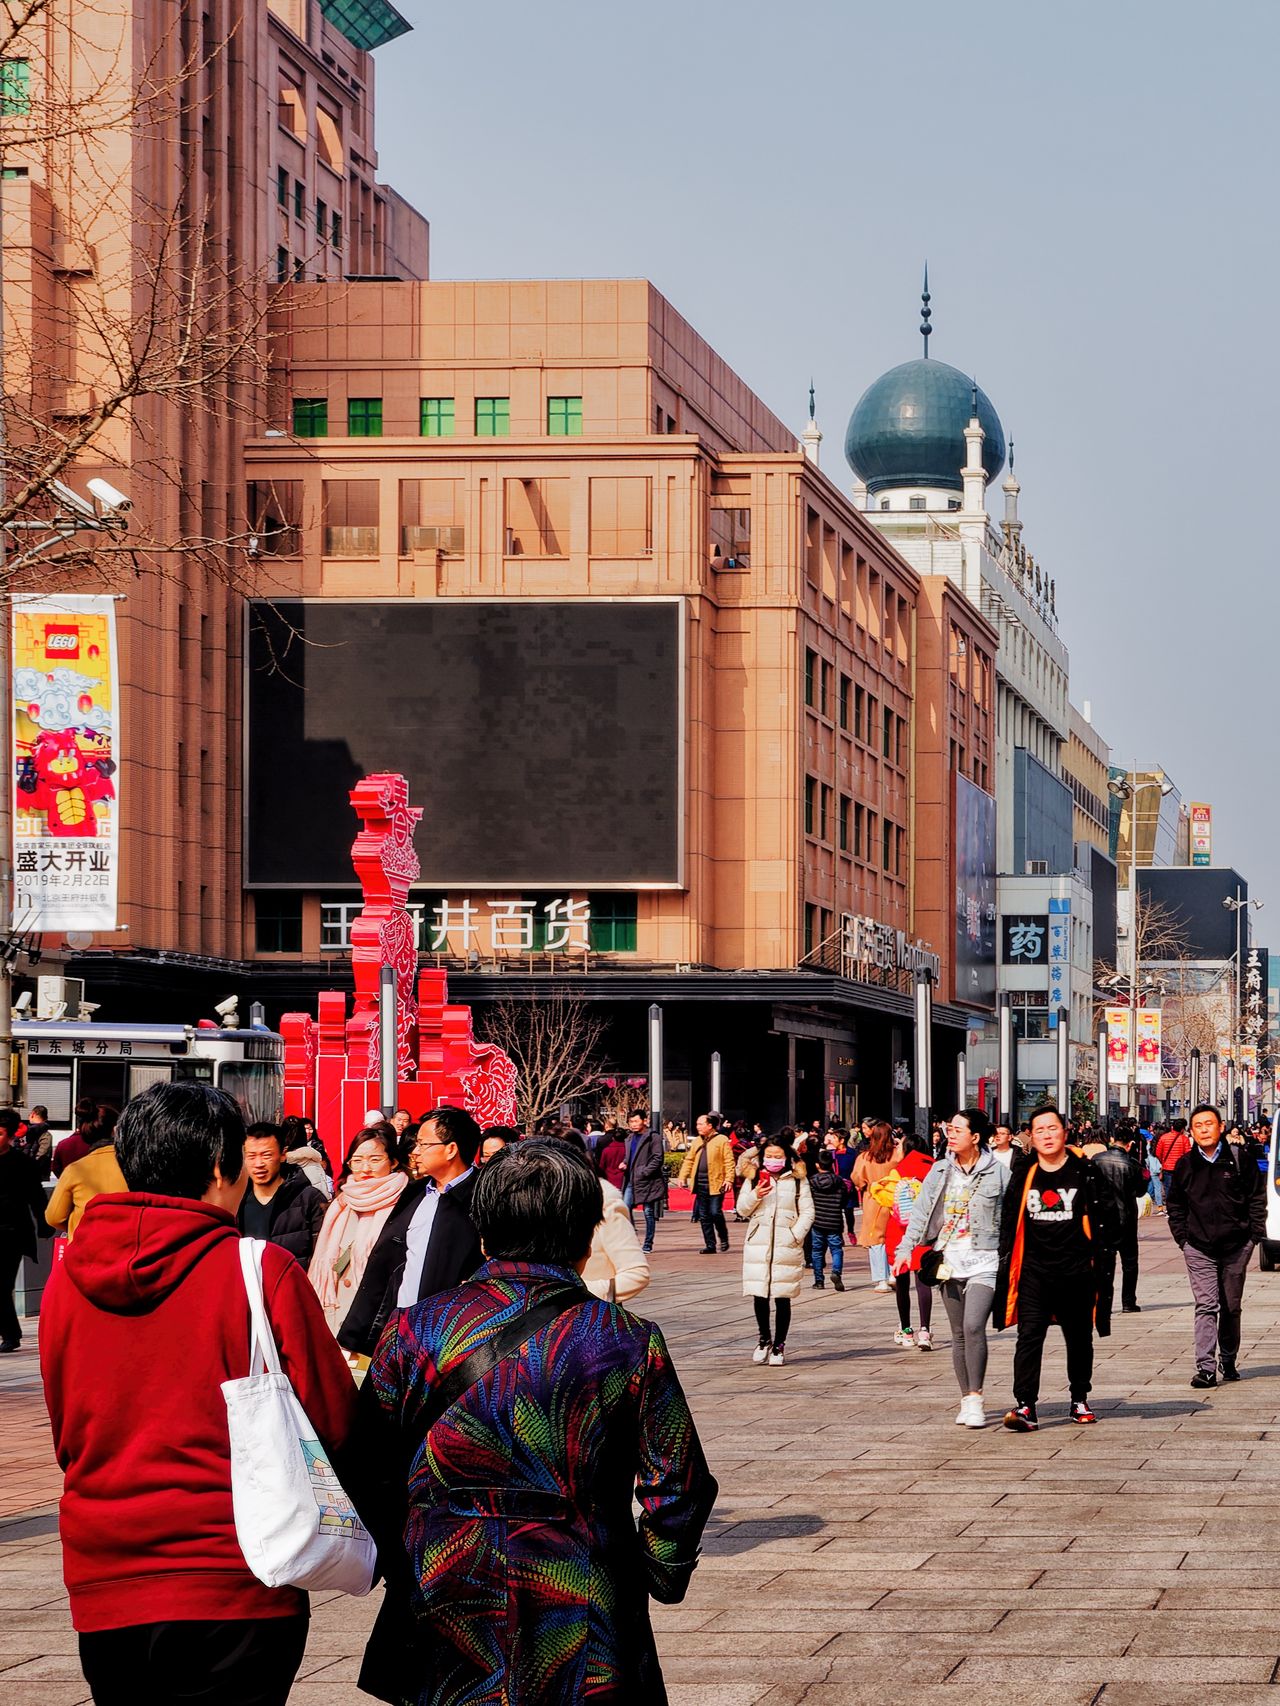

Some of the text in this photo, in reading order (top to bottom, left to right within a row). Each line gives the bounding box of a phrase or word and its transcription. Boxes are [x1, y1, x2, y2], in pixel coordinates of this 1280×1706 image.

[46, 634, 77, 649] LEGO
[16, 850, 110, 872] 盛大开业
[16, 874, 110, 886] 2019年2月22日
[1009, 922, 1045, 958] 药
